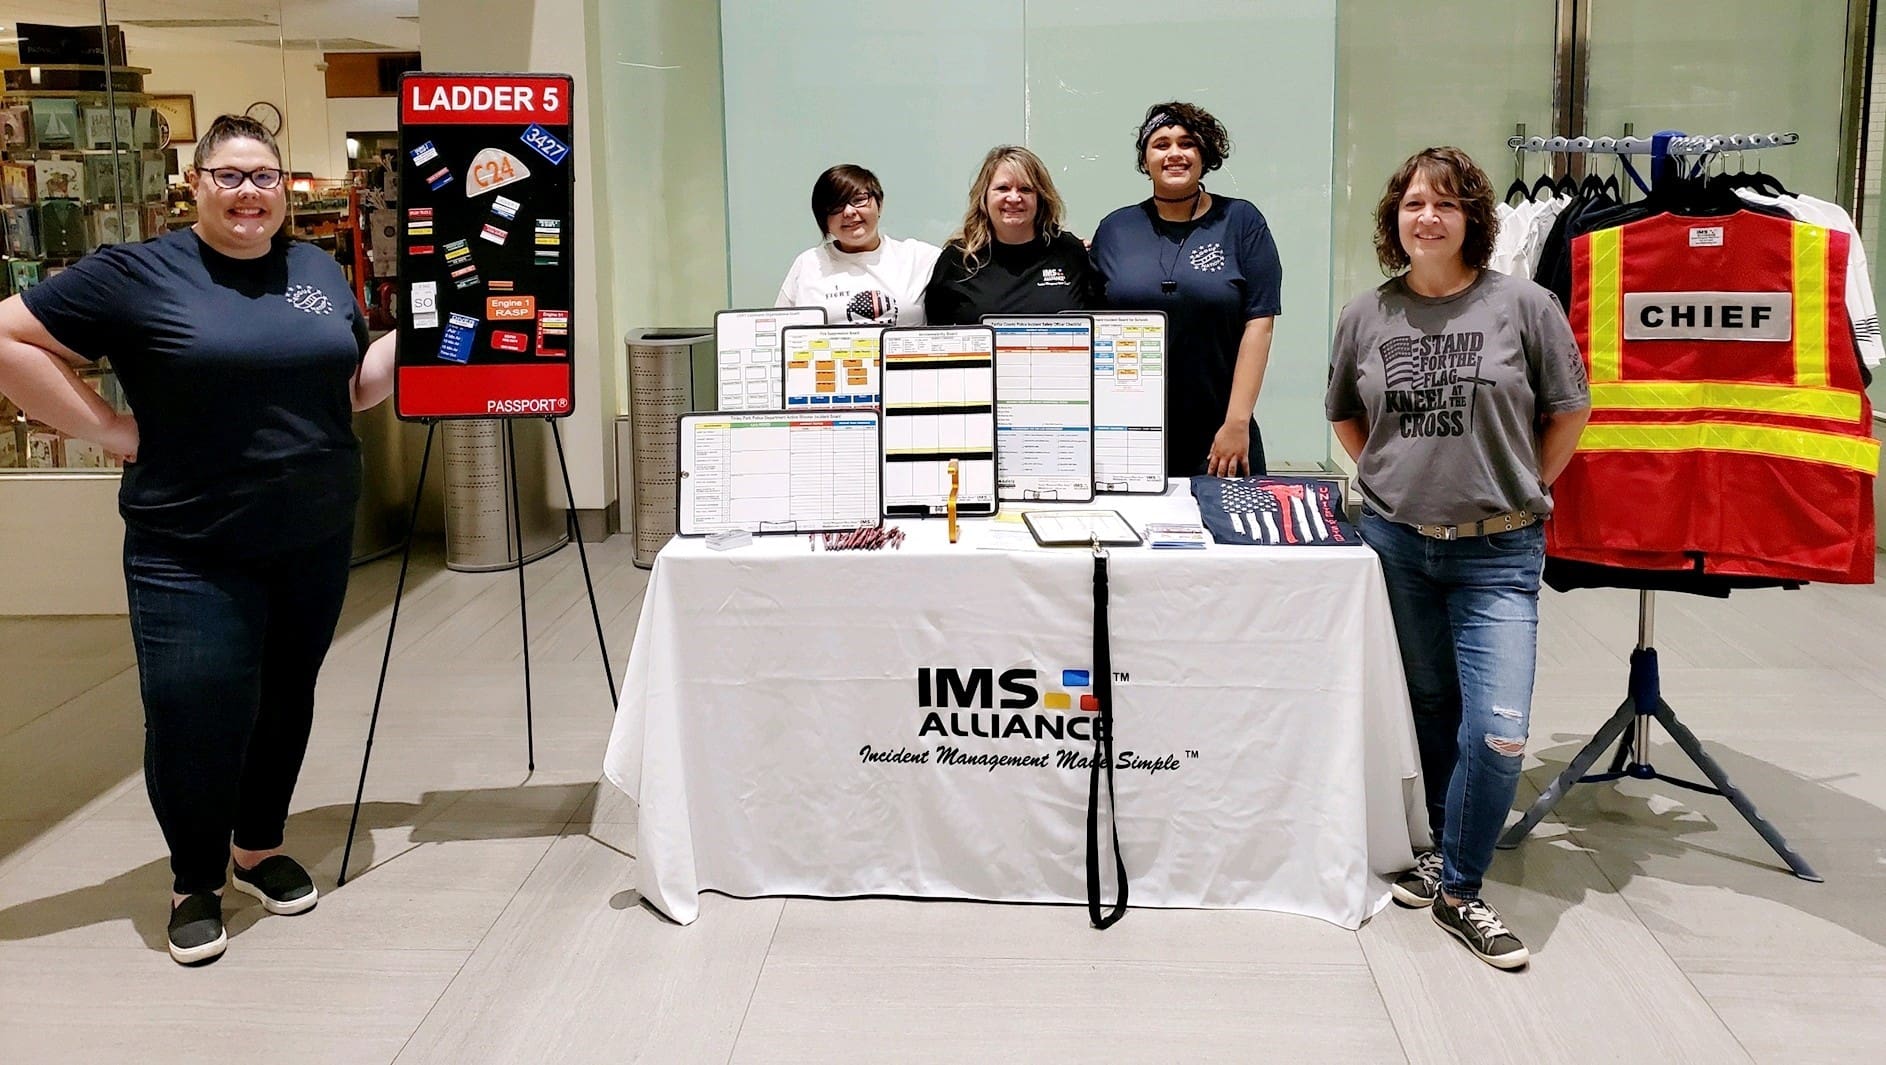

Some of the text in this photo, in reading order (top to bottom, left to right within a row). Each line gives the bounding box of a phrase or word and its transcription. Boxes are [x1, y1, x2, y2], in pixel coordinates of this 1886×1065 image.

[412, 86, 558, 112] LADDER 5
[526, 128, 564, 156] 3427
[473, 156, 514, 188] C24
[414, 298, 432, 308] SO
[492, 300, 522, 308] Engine
[496, 308, 529, 316] RASP
[1640, 305, 1772, 328] CHIEF
[1419, 332, 1484, 356] STAND
[1420, 353, 1476, 372] FOR THE
[1423, 370, 1459, 388] FLAG
[1452, 385, 1464, 396] AT
[1384, 388, 1447, 414] KNEEL
[1450, 396, 1466, 408] THE
[1400, 410, 1464, 439] CROSS
[918, 668, 1039, 709] IMS
[858, 744, 930, 765] Incident
[936, 745, 1049, 773] Management
[1116, 751, 1180, 774] Simple
